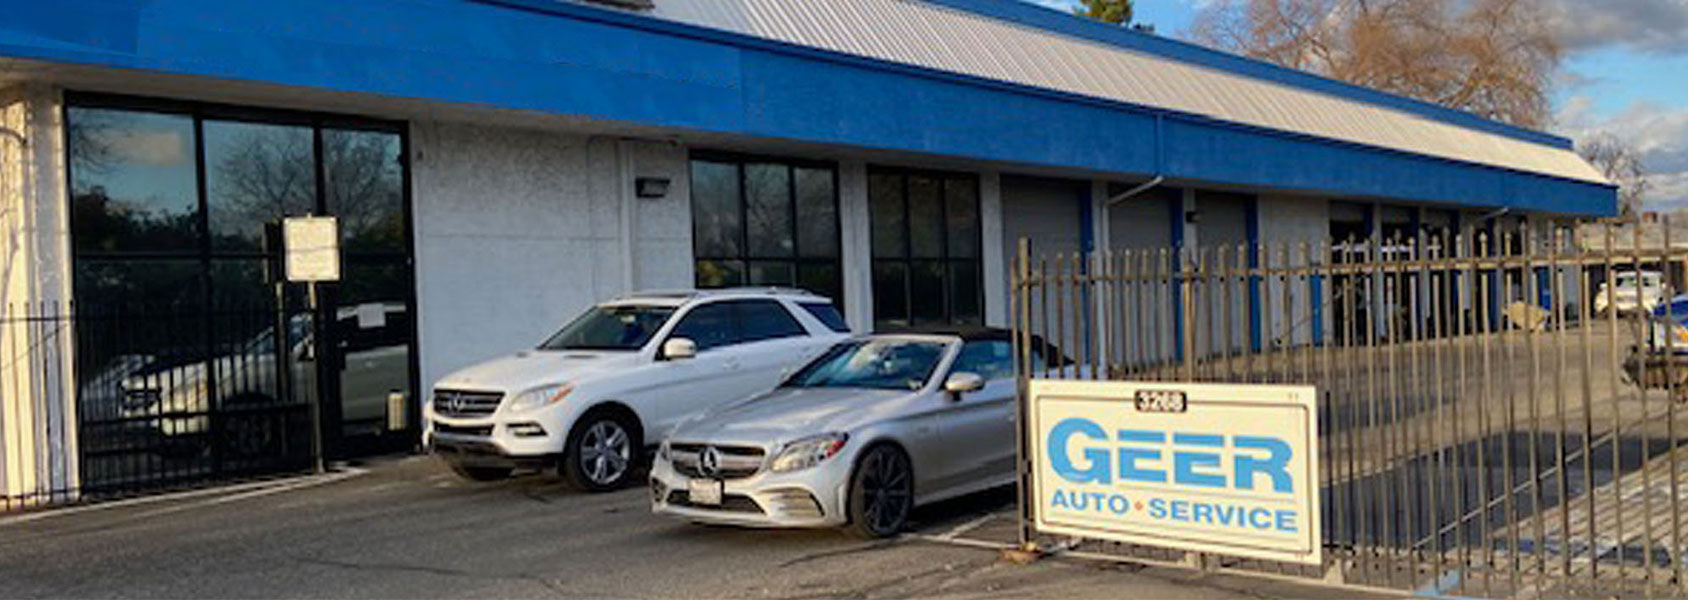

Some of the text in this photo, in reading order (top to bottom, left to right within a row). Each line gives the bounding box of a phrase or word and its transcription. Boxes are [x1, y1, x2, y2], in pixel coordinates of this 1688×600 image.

[1139, 391, 1183, 411] 3268
[1047, 418, 1294, 493] GEER
[1051, 489, 1299, 532] AUTO SERVICE
